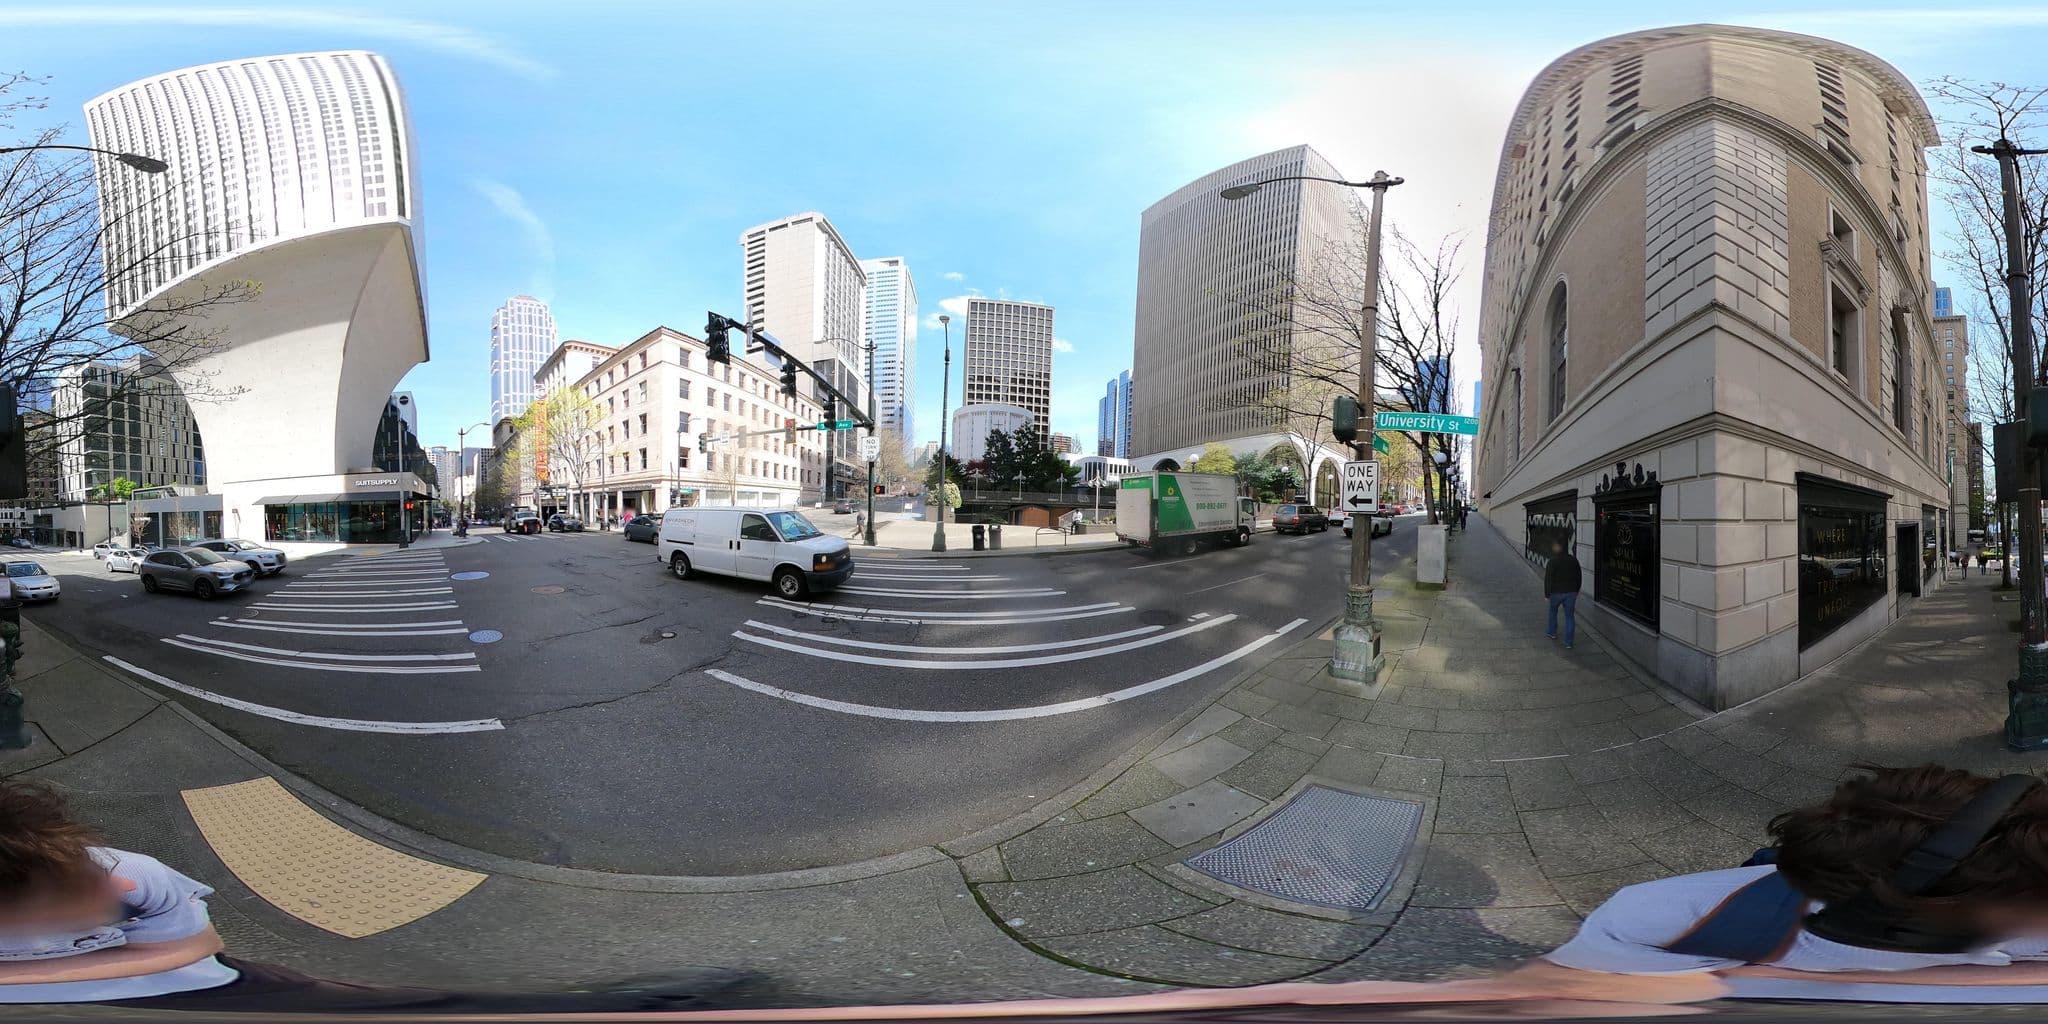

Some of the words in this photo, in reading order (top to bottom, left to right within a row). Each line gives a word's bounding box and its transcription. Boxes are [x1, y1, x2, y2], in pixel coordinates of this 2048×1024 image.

[1380, 413, 1444, 431] University
[1449, 420, 1459, 431] St
[1348, 465, 1374, 477] ONE
[355, 478, 398, 486] SUITSUPPLY
[1346, 480, 1374, 492] WAY
[1816, 528, 1846, 543] WHERE
